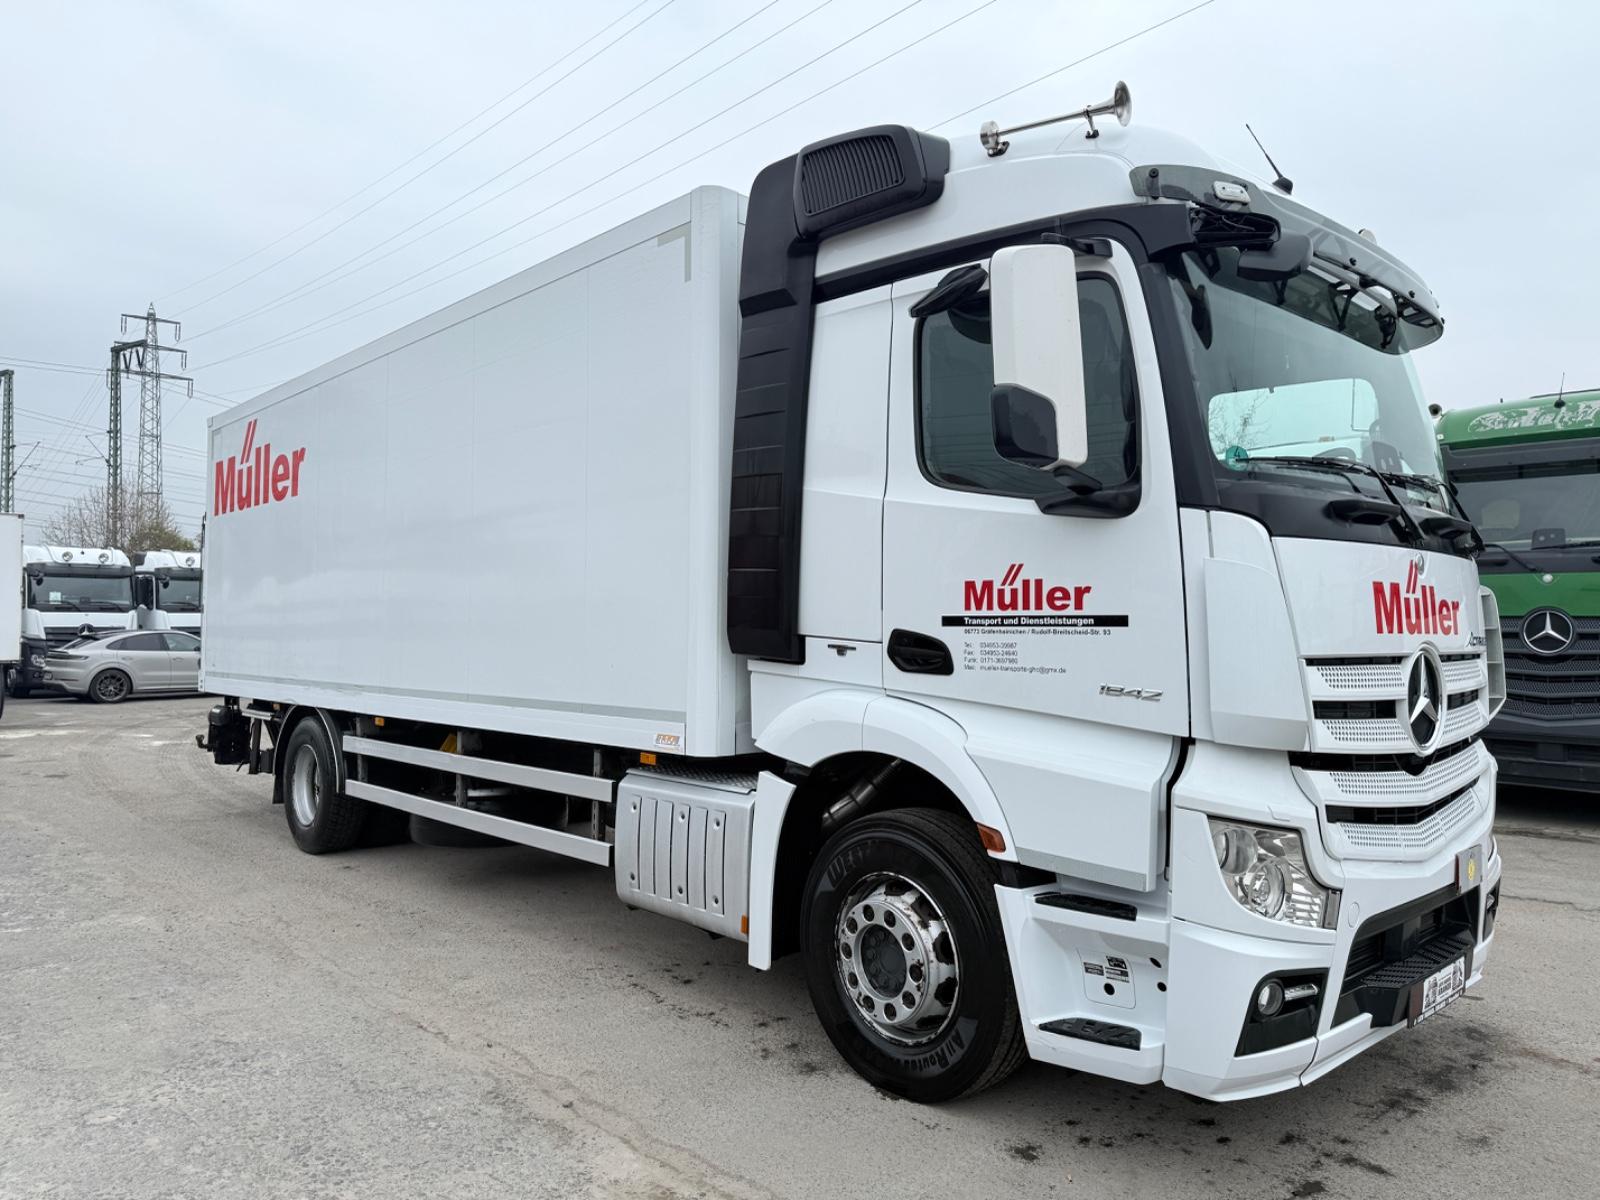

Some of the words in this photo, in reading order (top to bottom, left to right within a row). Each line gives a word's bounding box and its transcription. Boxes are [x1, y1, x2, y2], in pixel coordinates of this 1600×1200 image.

[214, 418, 306, 517] Müller
[964, 563, 1092, 612] Müller
[1372, 560, 1460, 635] Müller
[964, 616, 1002, 626] Transport
[1003, 616, 1019, 625] und
[1020, 616, 1095, 627] Dienstleistungen
